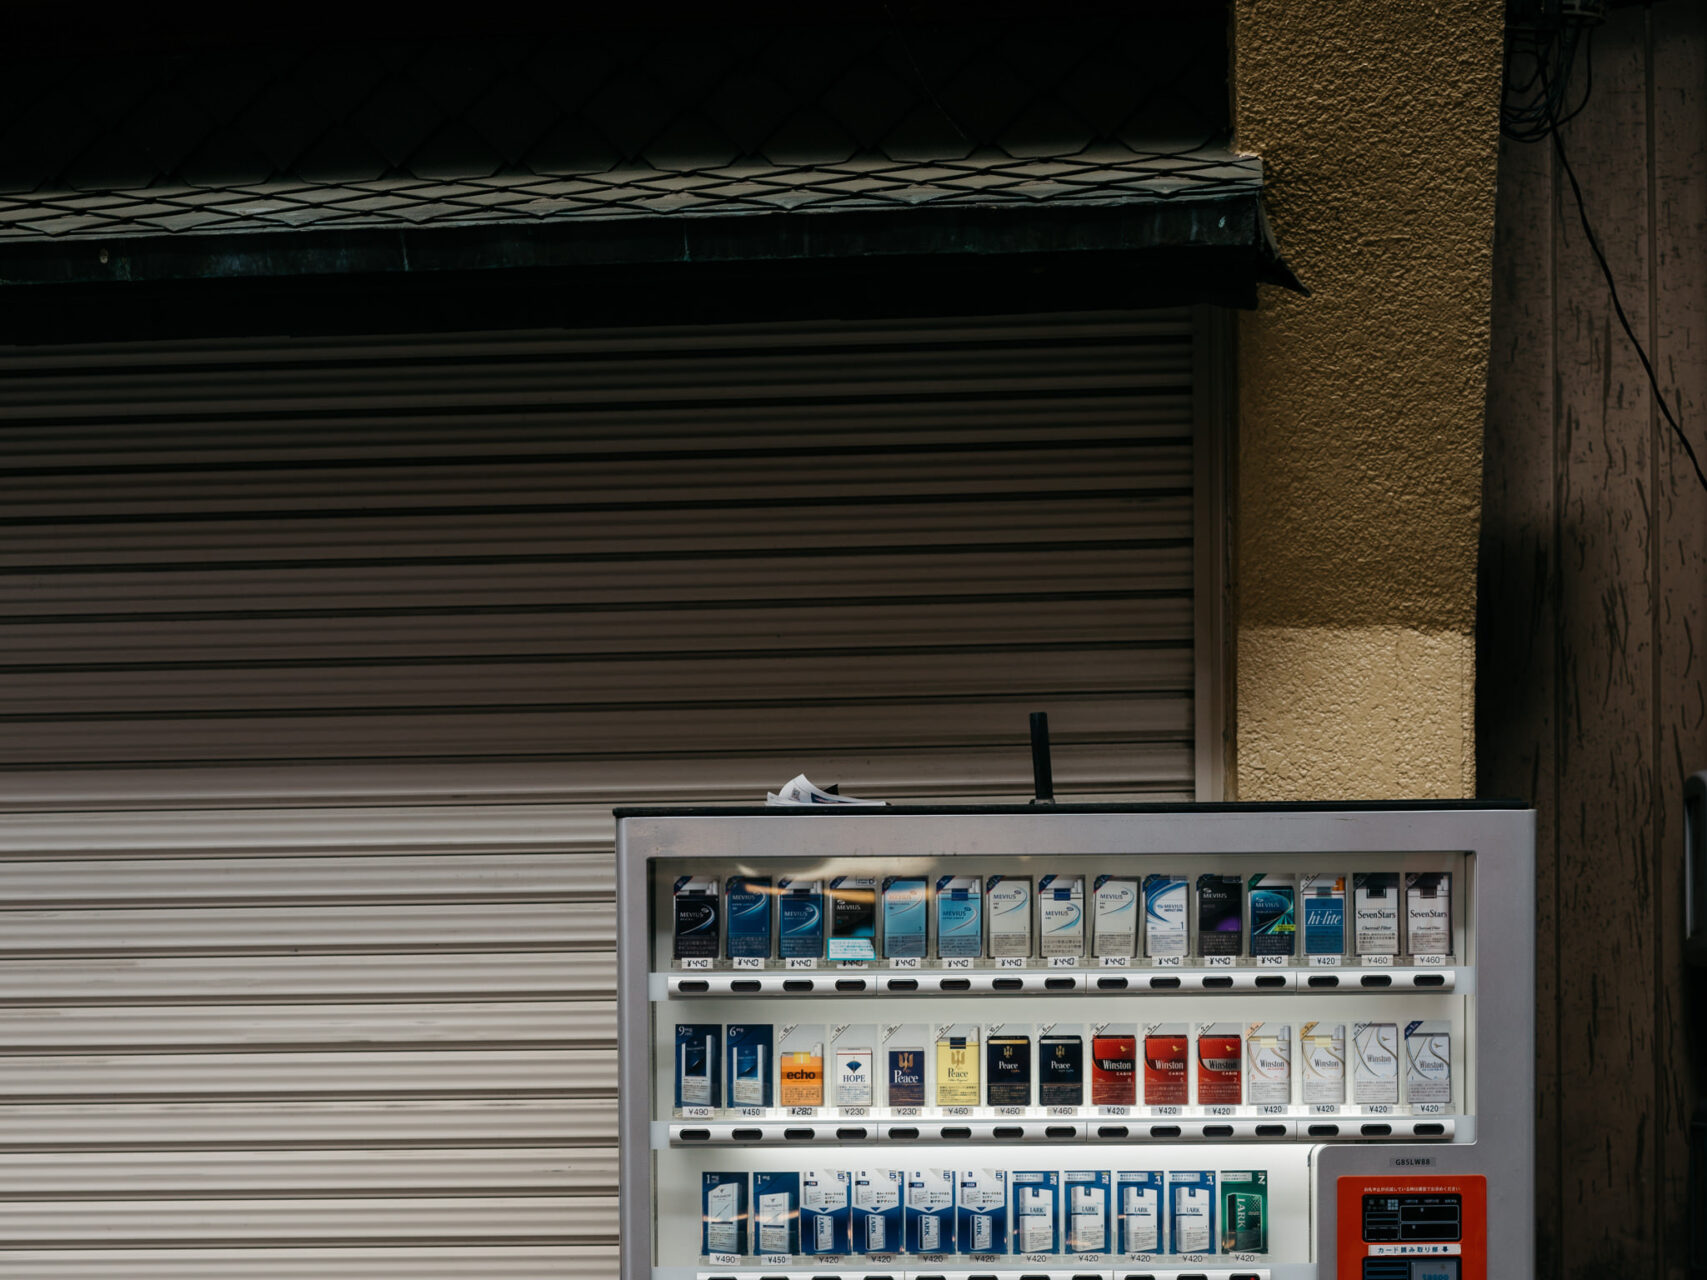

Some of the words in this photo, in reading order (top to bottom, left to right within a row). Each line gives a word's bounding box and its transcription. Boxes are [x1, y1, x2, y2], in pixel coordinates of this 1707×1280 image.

[1308, 911, 1341, 925] hi-lite
[1315, 1059, 1339, 1067] Winston
[1367, 1055, 1391, 1063] Winston
[999, 1061, 1018, 1070] Peace
[1051, 1061, 1071, 1070] Peace
[1103, 1061, 1132, 1070] Winston
[1155, 1060, 1184, 1069] Winston
[1209, 1060, 1237, 1069] Winston
[787, 1069, 815, 1079] echo
[895, 1070, 919, 1083] Peace
[948, 1068, 968, 1078] Peace
[1237, 1198, 1246, 1228] LARK
[923, 1255, 943, 1263] ¥420
[1235, 1254, 1255, 1262] ¥420
